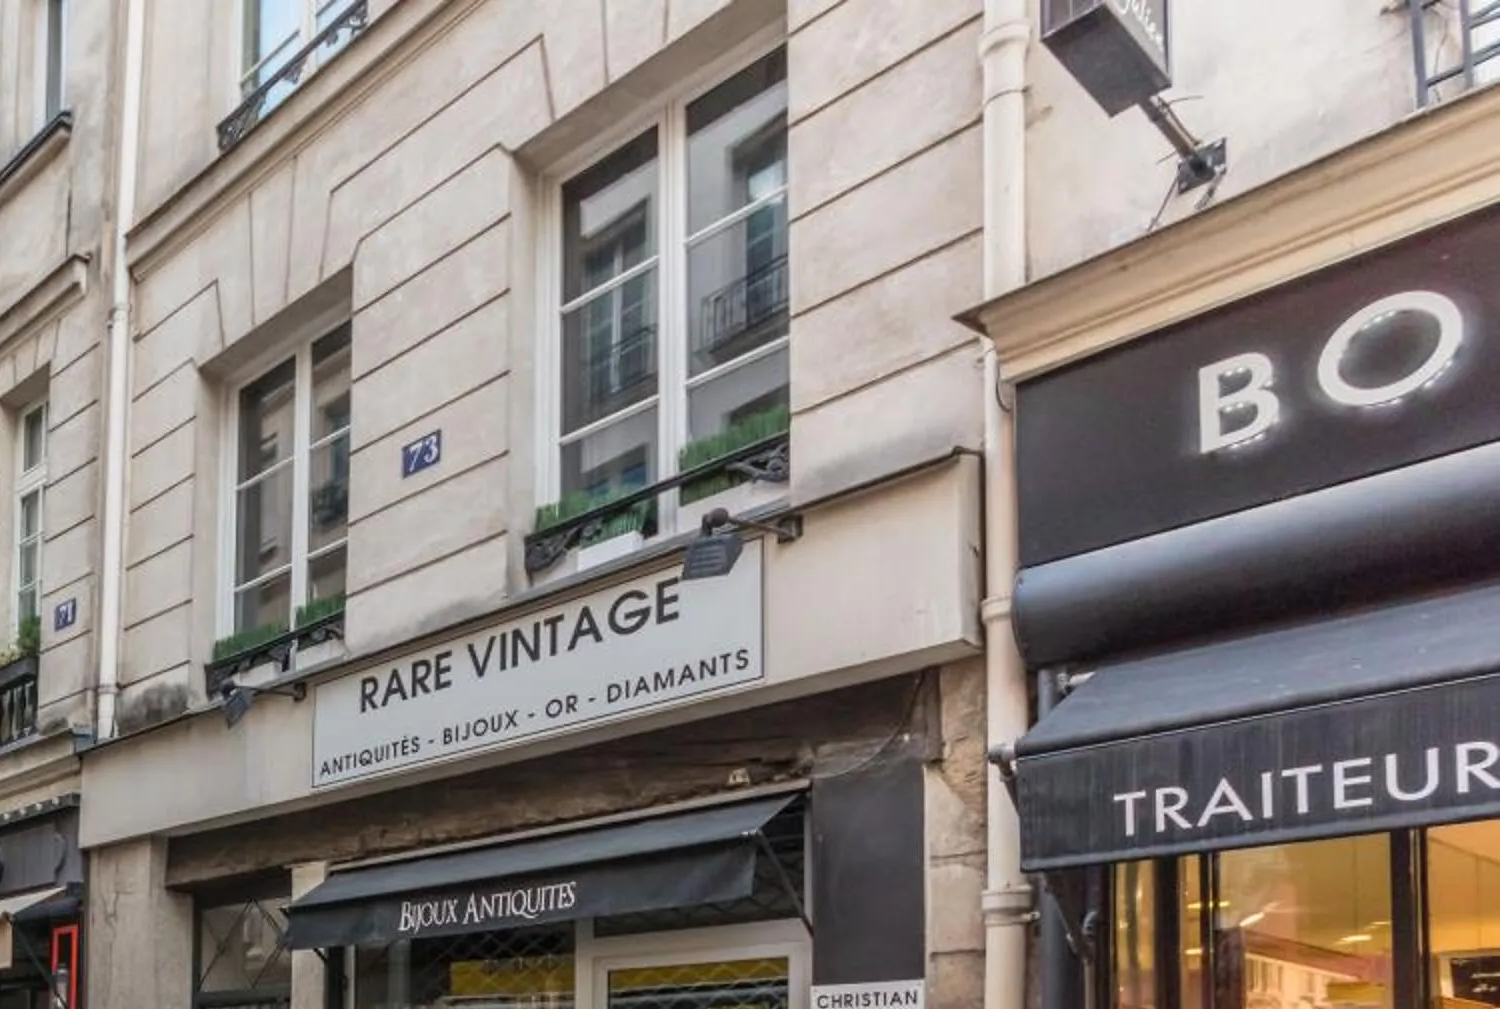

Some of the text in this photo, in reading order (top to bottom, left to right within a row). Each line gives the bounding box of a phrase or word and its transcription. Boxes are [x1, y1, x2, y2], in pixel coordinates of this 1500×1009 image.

[1198, 290, 1463, 454] BO
[409, 435, 439, 472] 73
[359, 577, 680, 714] RARE VINTAGE
[443, 710, 518, 746] BIJOUX
[545, 694, 578, 719] OR
[607, 649, 749, 704] DIAMANTS
[1113, 741, 1500, 837] TRAITEUR
[398, 900, 458, 934] BIJOUX
[817, 990, 918, 1009] CHRISTIAN
